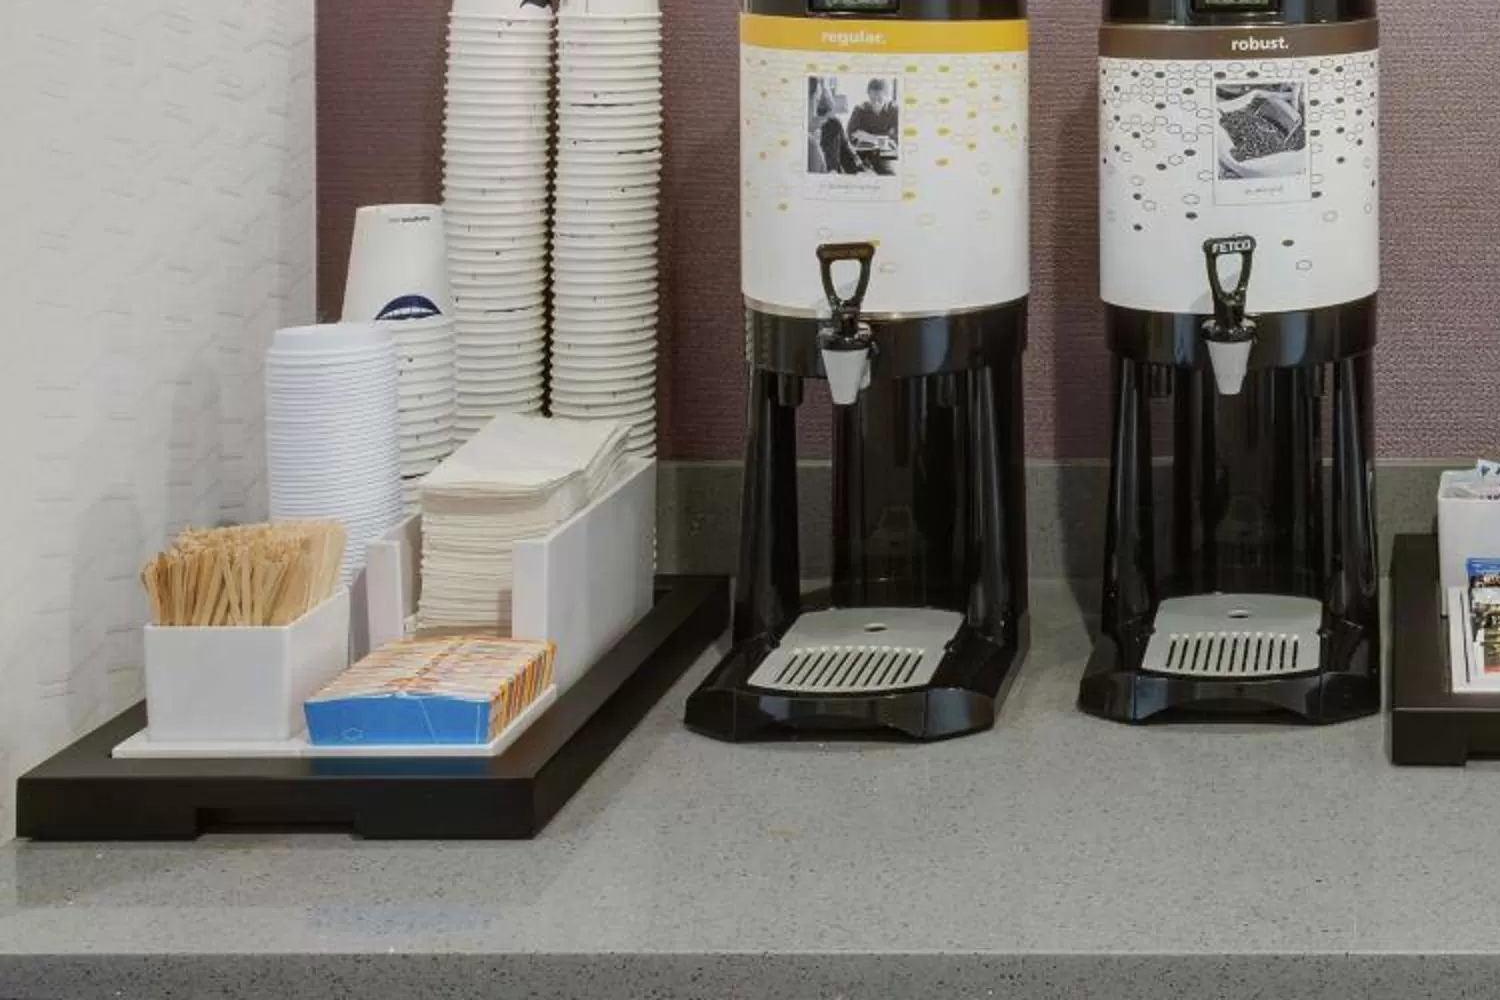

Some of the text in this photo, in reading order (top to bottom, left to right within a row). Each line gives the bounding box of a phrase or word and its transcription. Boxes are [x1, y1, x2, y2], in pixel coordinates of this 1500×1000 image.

[821, 29, 887, 48] regular.
[1231, 36, 1289, 51] robust.
[1211, 239, 1251, 253] FETCO
